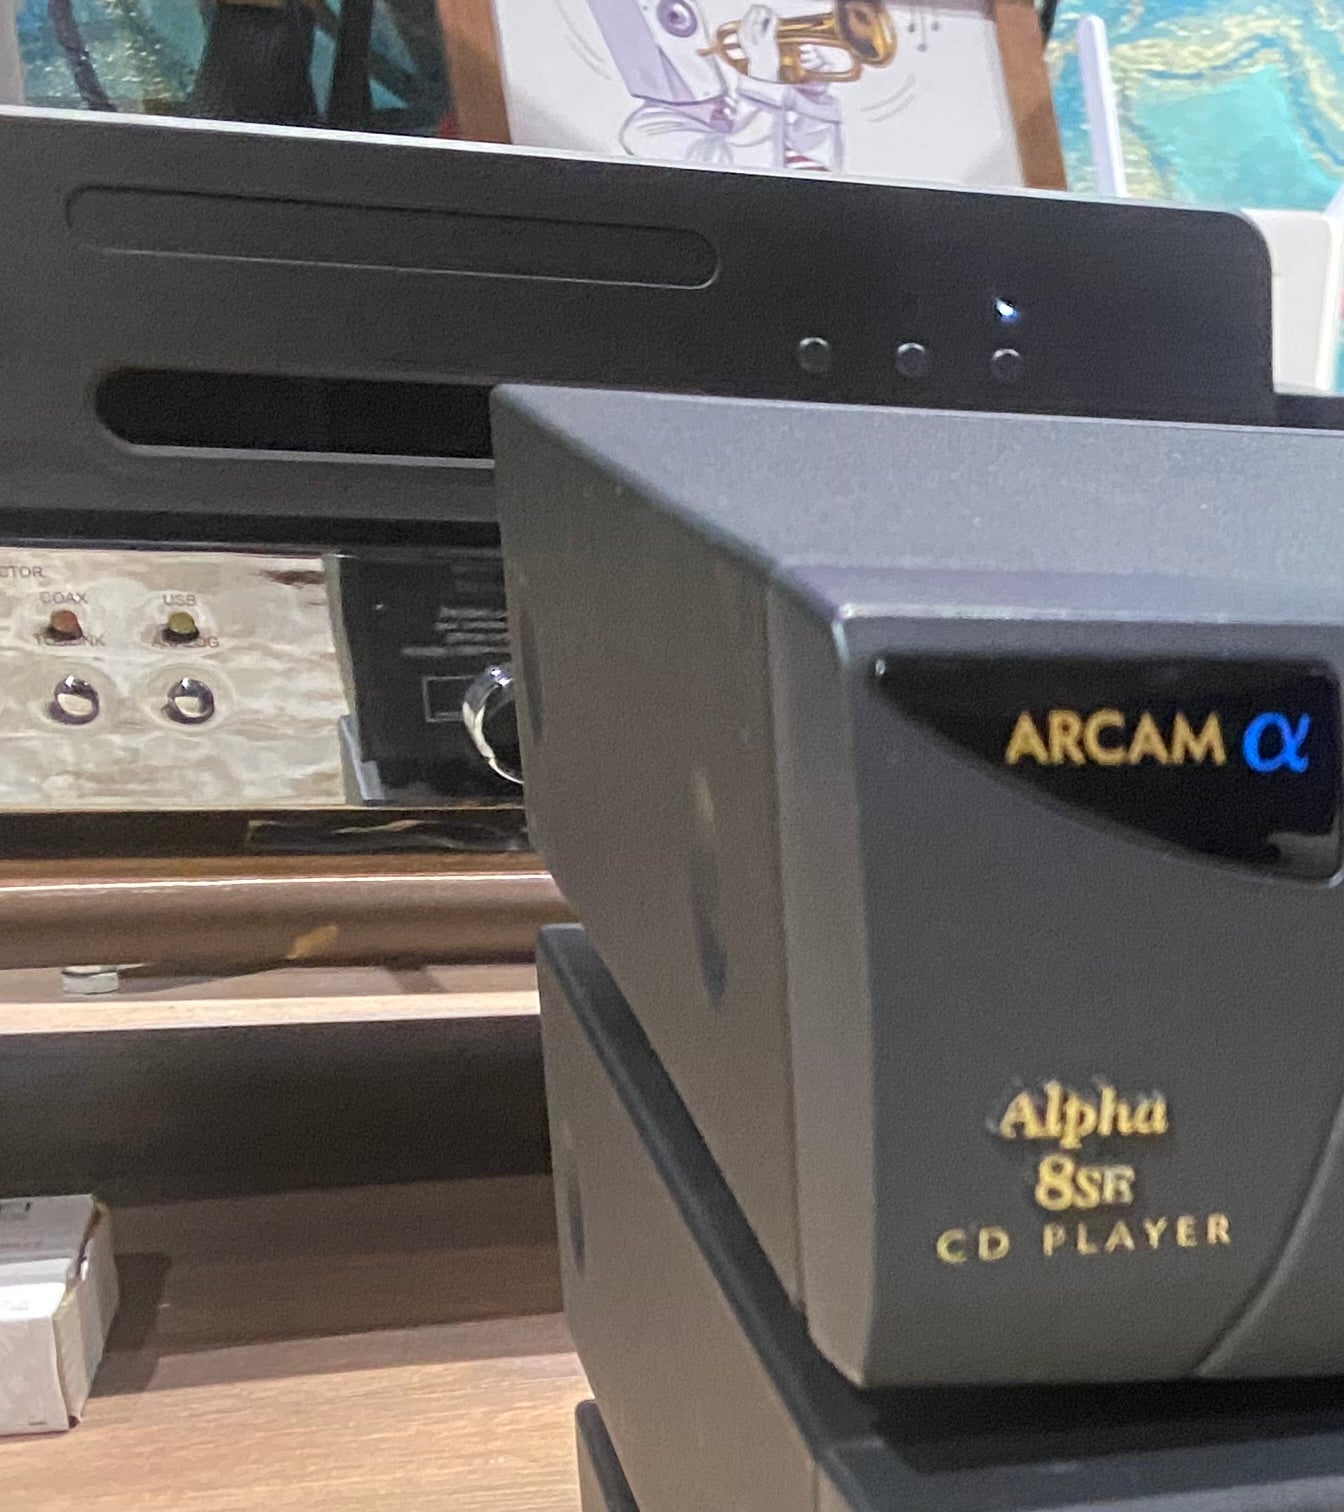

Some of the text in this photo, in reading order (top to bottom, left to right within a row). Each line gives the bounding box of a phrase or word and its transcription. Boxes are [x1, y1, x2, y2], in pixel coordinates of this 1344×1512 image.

[39, 591, 88, 604] COAX
[162, 593, 197, 607] USB
[1006, 708, 1226, 766] ARCAM
[998, 1079, 1169, 1149] Alpha
[936, 1212, 1231, 1264] CD PLAYER
